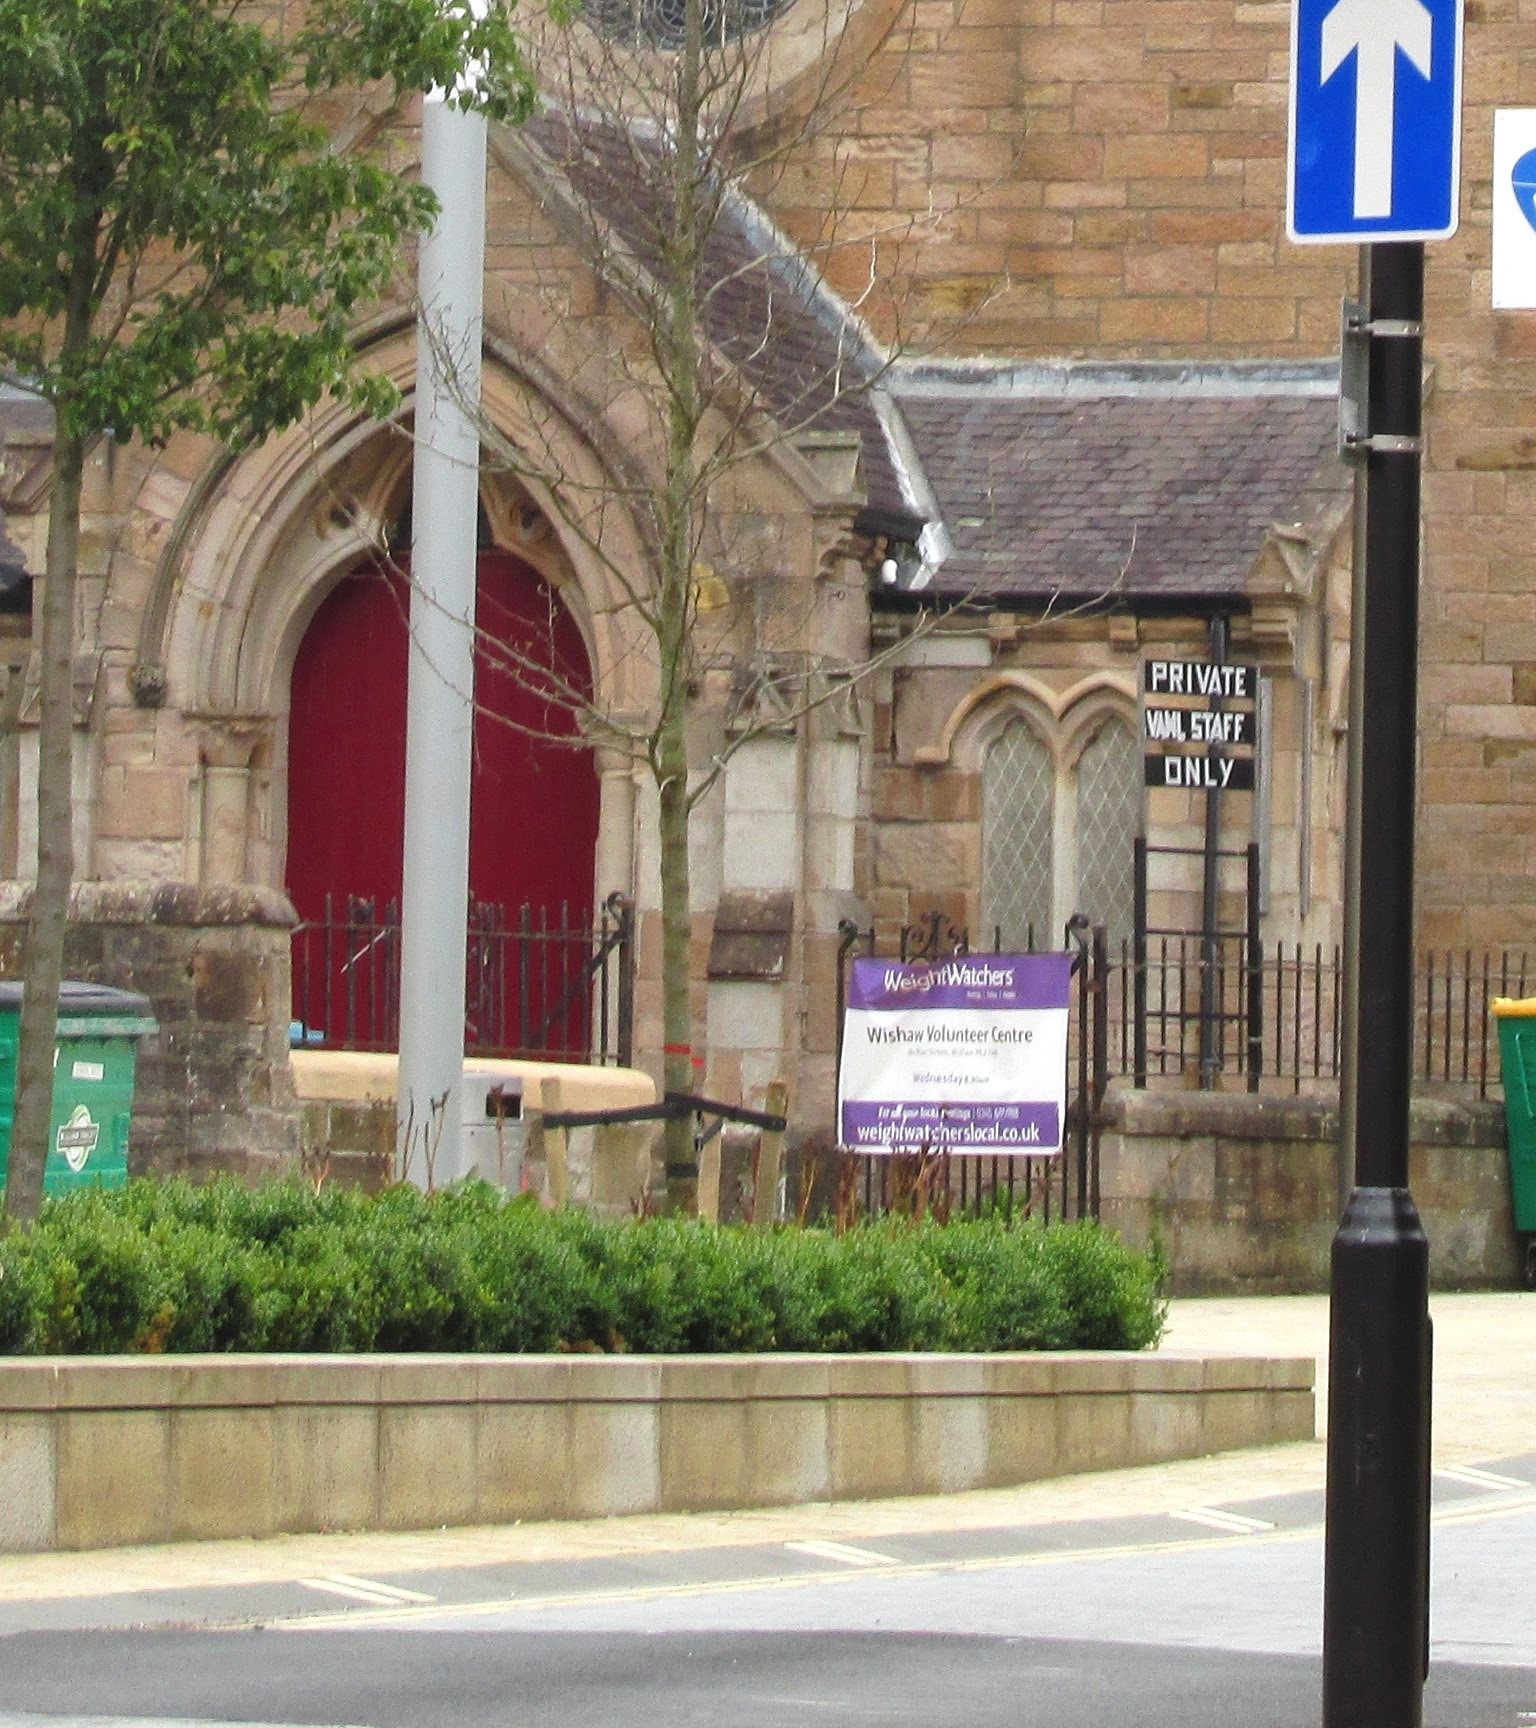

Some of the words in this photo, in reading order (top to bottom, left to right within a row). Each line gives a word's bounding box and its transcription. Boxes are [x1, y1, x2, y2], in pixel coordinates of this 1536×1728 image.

[1151, 661, 1246, 697] PRIVATE
[1191, 710, 1245, 742] STAFF
[1164, 755, 1234, 787] ONLY
[884, 963, 1013, 992] WeightWatchers
[867, 1026, 923, 1044] Wishaw
[926, 1024, 989, 1043] Volunteer
[991, 1025, 1033, 1043] Centre
[913, 1072, 962, 1087] Wednesday
[857, 1121, 1040, 1146] weightwatcherslocal.co.uk
